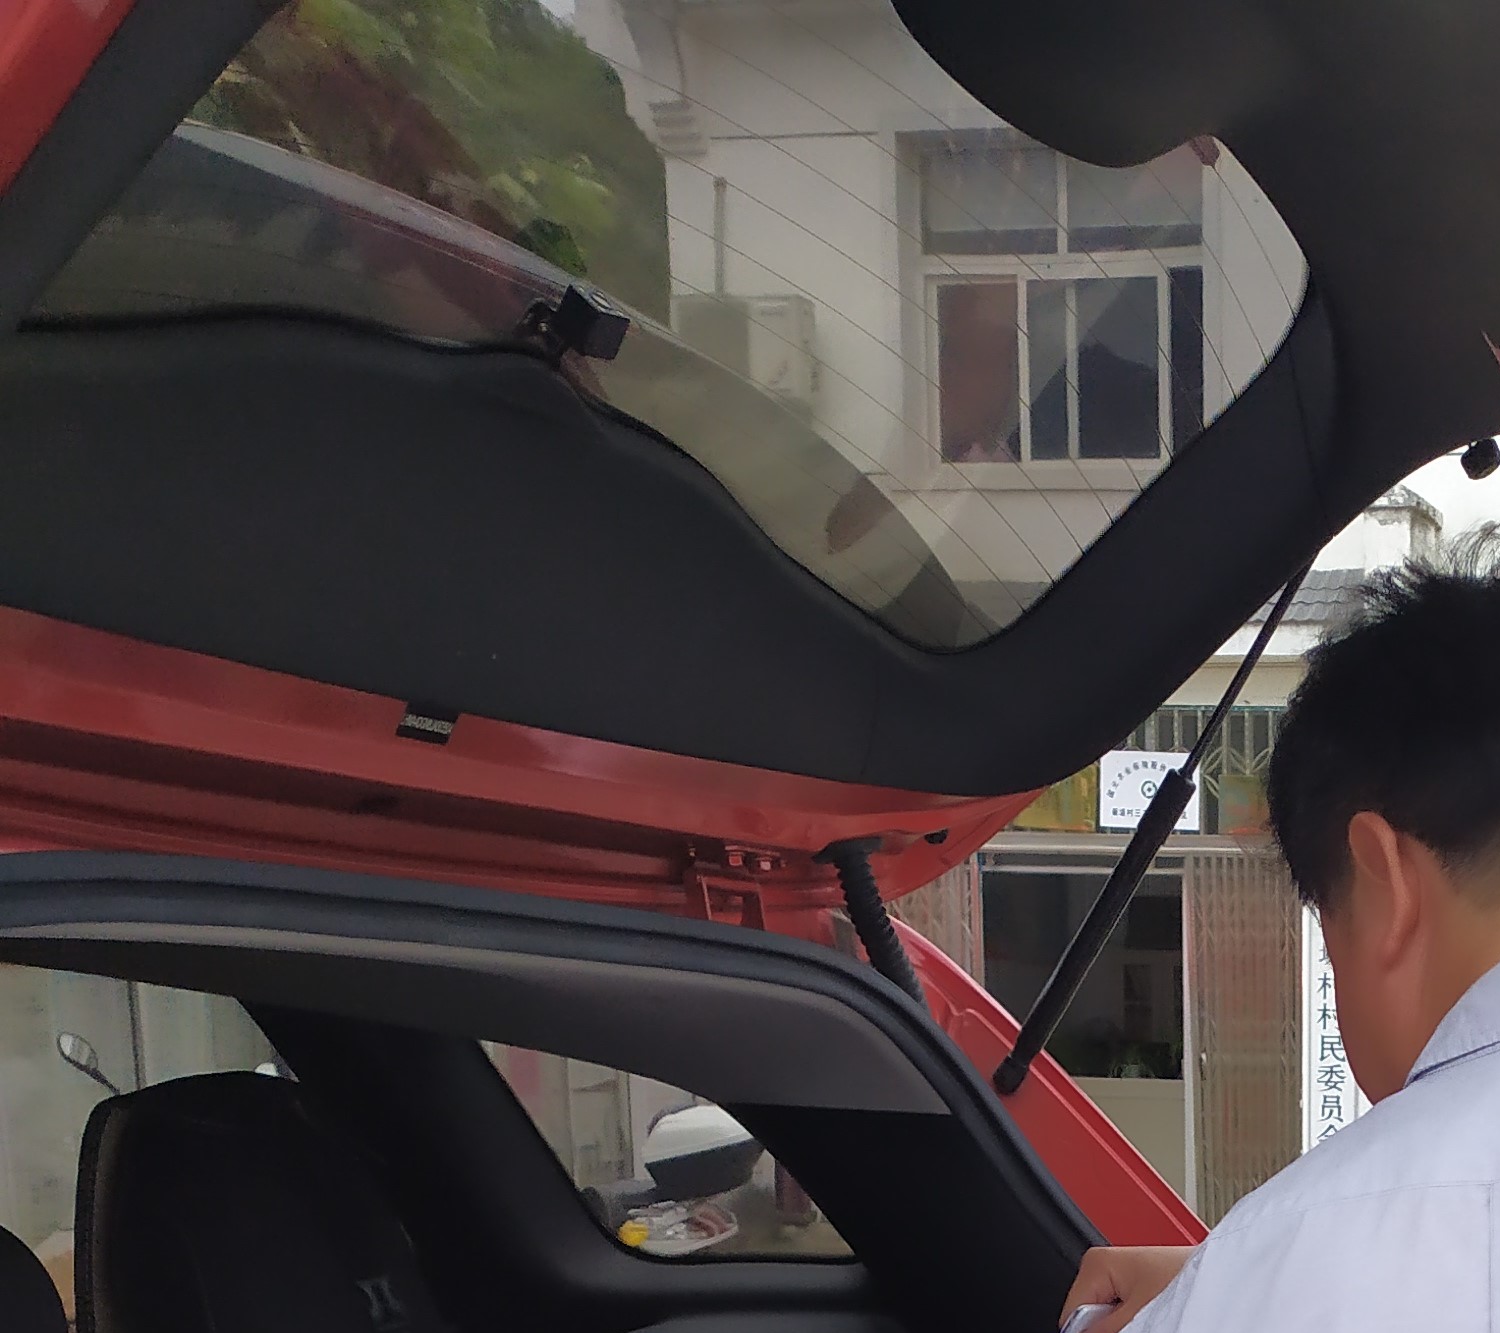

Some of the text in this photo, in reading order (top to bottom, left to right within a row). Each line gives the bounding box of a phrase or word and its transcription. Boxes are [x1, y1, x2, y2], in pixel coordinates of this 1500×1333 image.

[1316, 944, 1347, 1142] 村村民委员
